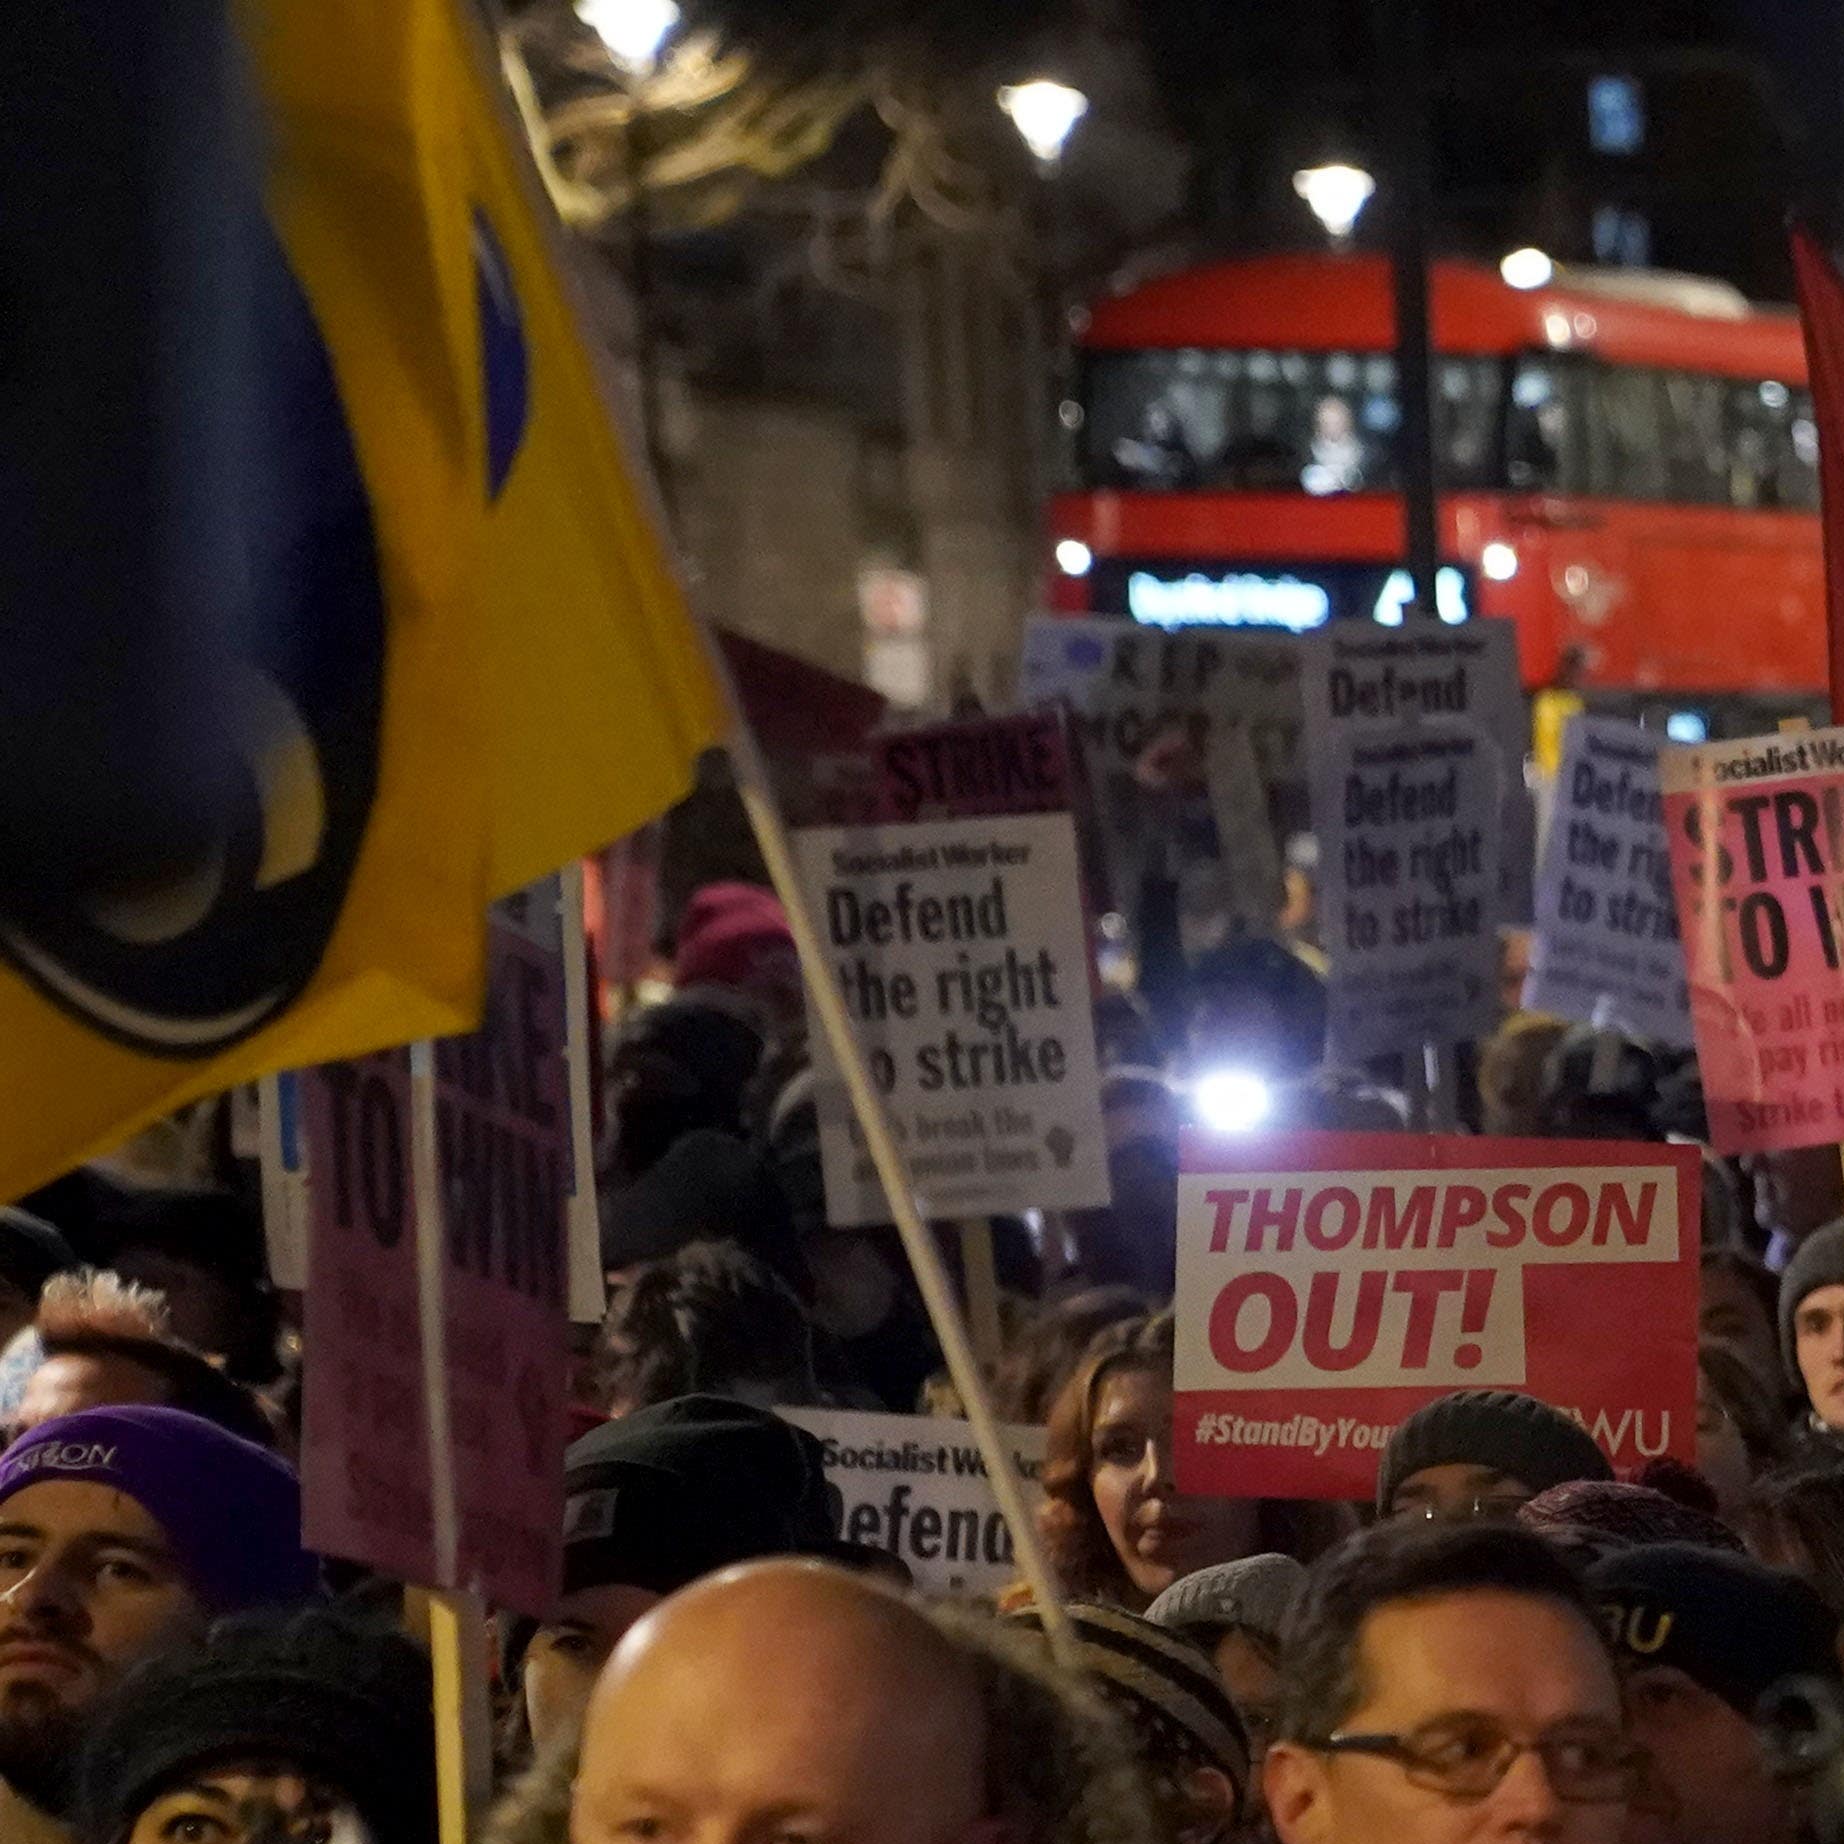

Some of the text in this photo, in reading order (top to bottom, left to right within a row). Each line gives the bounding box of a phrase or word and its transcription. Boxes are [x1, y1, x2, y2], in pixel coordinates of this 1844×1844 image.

[1345, 765, 1457, 829] Defend
[1344, 834, 1399, 889] the
[826, 877, 1008, 947] Defend
[935, 949, 1063, 1035] right
[867, 1028, 1068, 1096] o strike
[1206, 1181, 1658, 1253] THOMPSON
[1207, 1267, 1498, 1374] OUT!
[1195, 1412, 1397, 1456] #StandByYou
